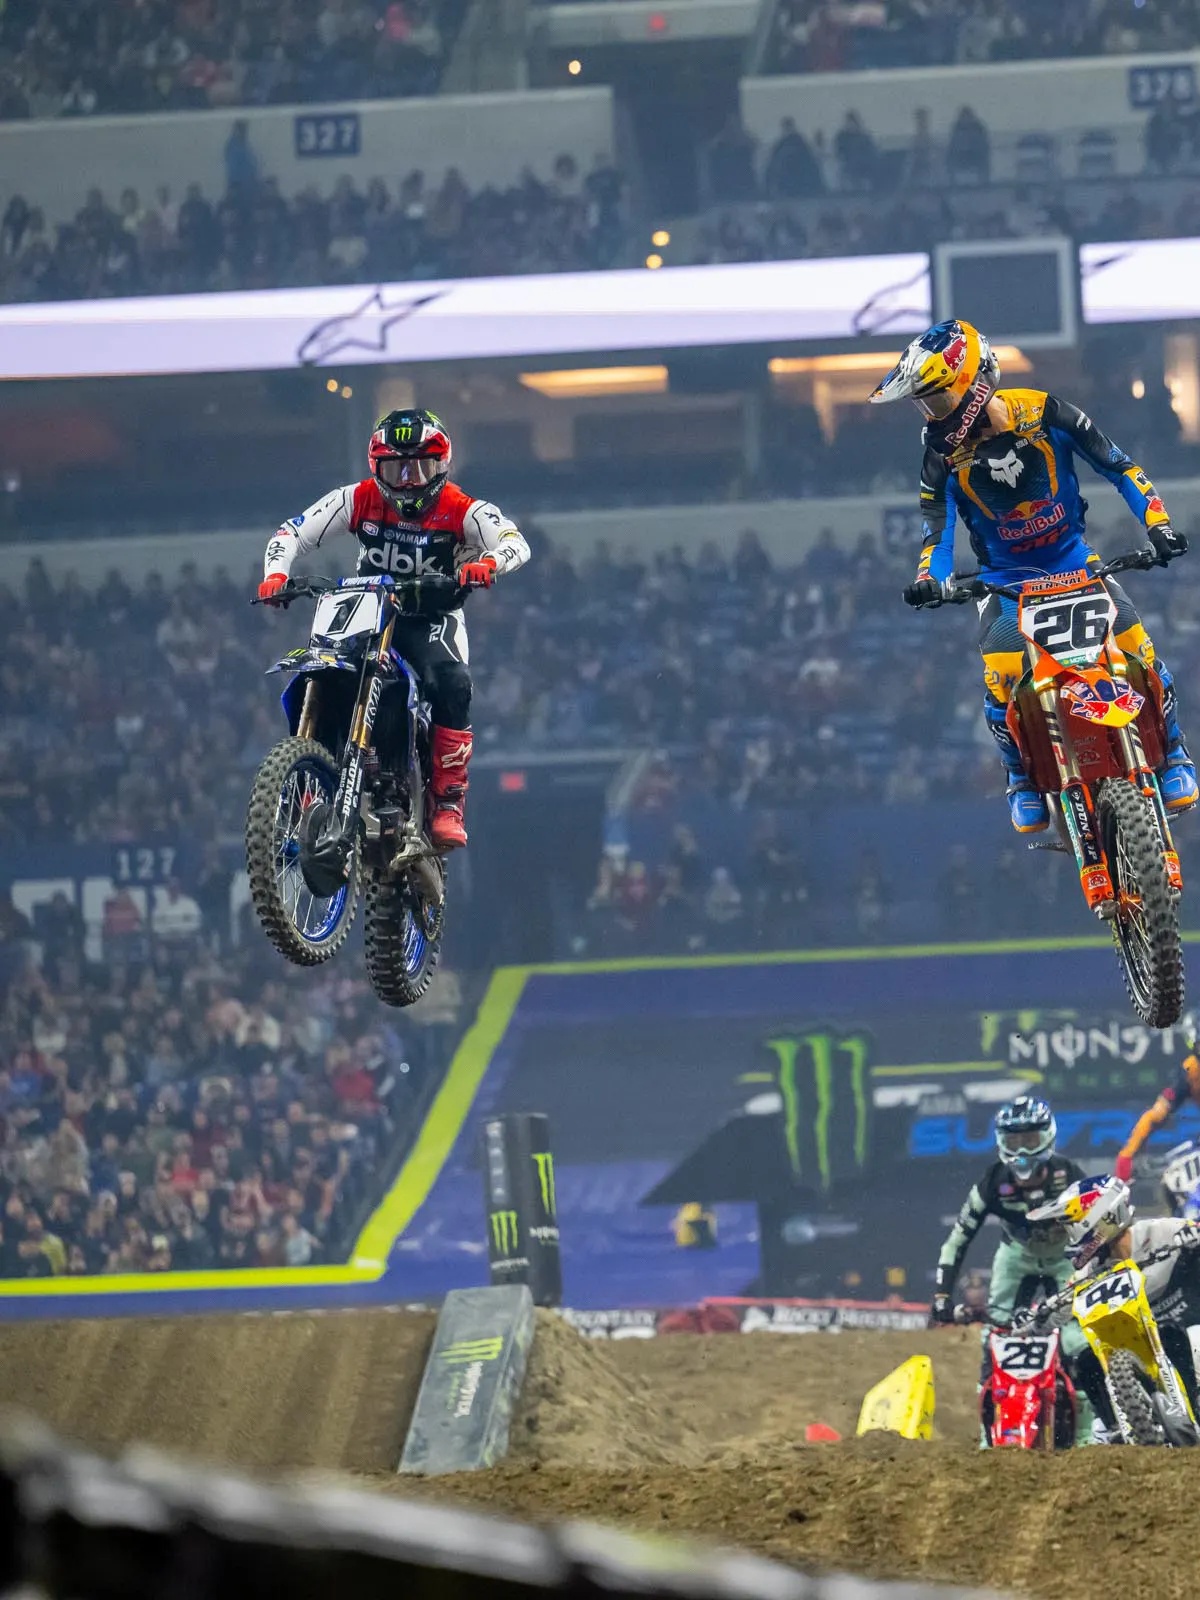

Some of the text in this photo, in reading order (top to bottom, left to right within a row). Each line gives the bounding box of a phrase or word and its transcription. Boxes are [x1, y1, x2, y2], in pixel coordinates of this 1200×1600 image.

[945, 413, 976, 447] Red
[964, 381, 990, 418] Bull
[395, 531, 428, 545] YAMAHA
[997, 502, 1066, 541] Red Bull
[367, 541, 438, 576] dbk
[326, 594, 366, 636] 1
[429, 622, 442, 644] FLY
[1033, 598, 1111, 656] 26
[342, 757, 359, 817] DUNLOP
[117, 847, 176, 880] 127
[1001, 1342, 1049, 1370] 28
